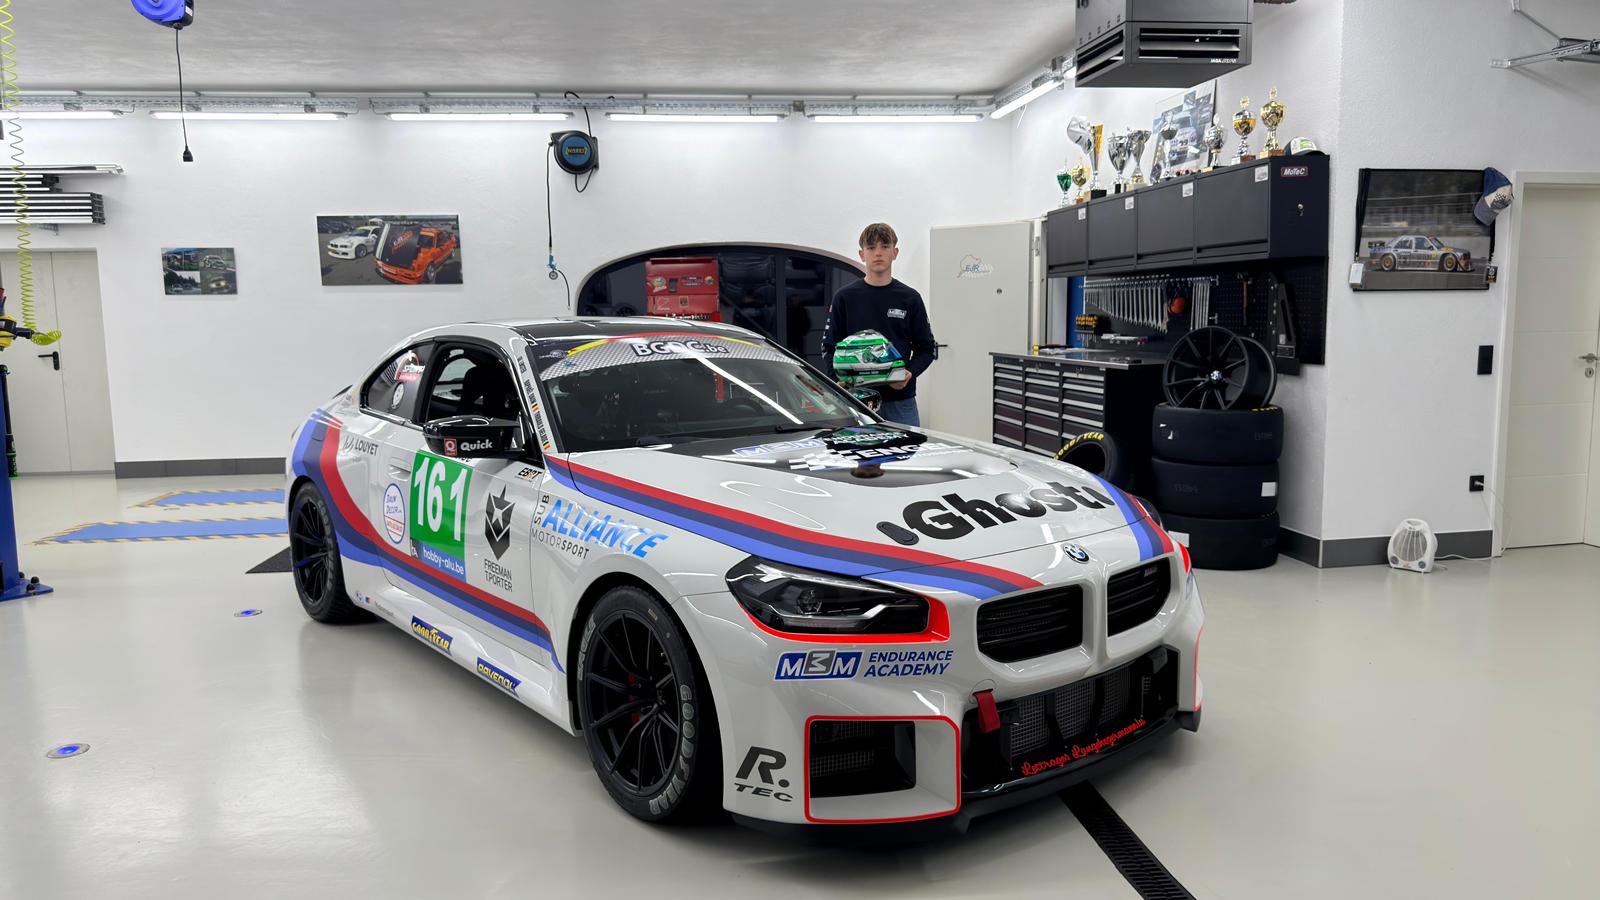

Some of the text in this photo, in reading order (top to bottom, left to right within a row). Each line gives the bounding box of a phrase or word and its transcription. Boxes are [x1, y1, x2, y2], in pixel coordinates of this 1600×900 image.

[354, 439, 379, 456] LOUYET
[460, 438, 493, 452] Quick
[413, 456, 468, 542] 161
[533, 494, 550, 526] SUB
[541, 499, 669, 558] ALLIANCE
[531, 528, 590, 560] MOTORSPORT
[422, 546, 465, 575] hobby-alu.be
[484, 558, 512, 581] FREEMAN
[869, 651, 954, 663] ENDURANCE
[864, 662, 950, 678] ACADEMY
[734, 782, 794, 802] TEC
